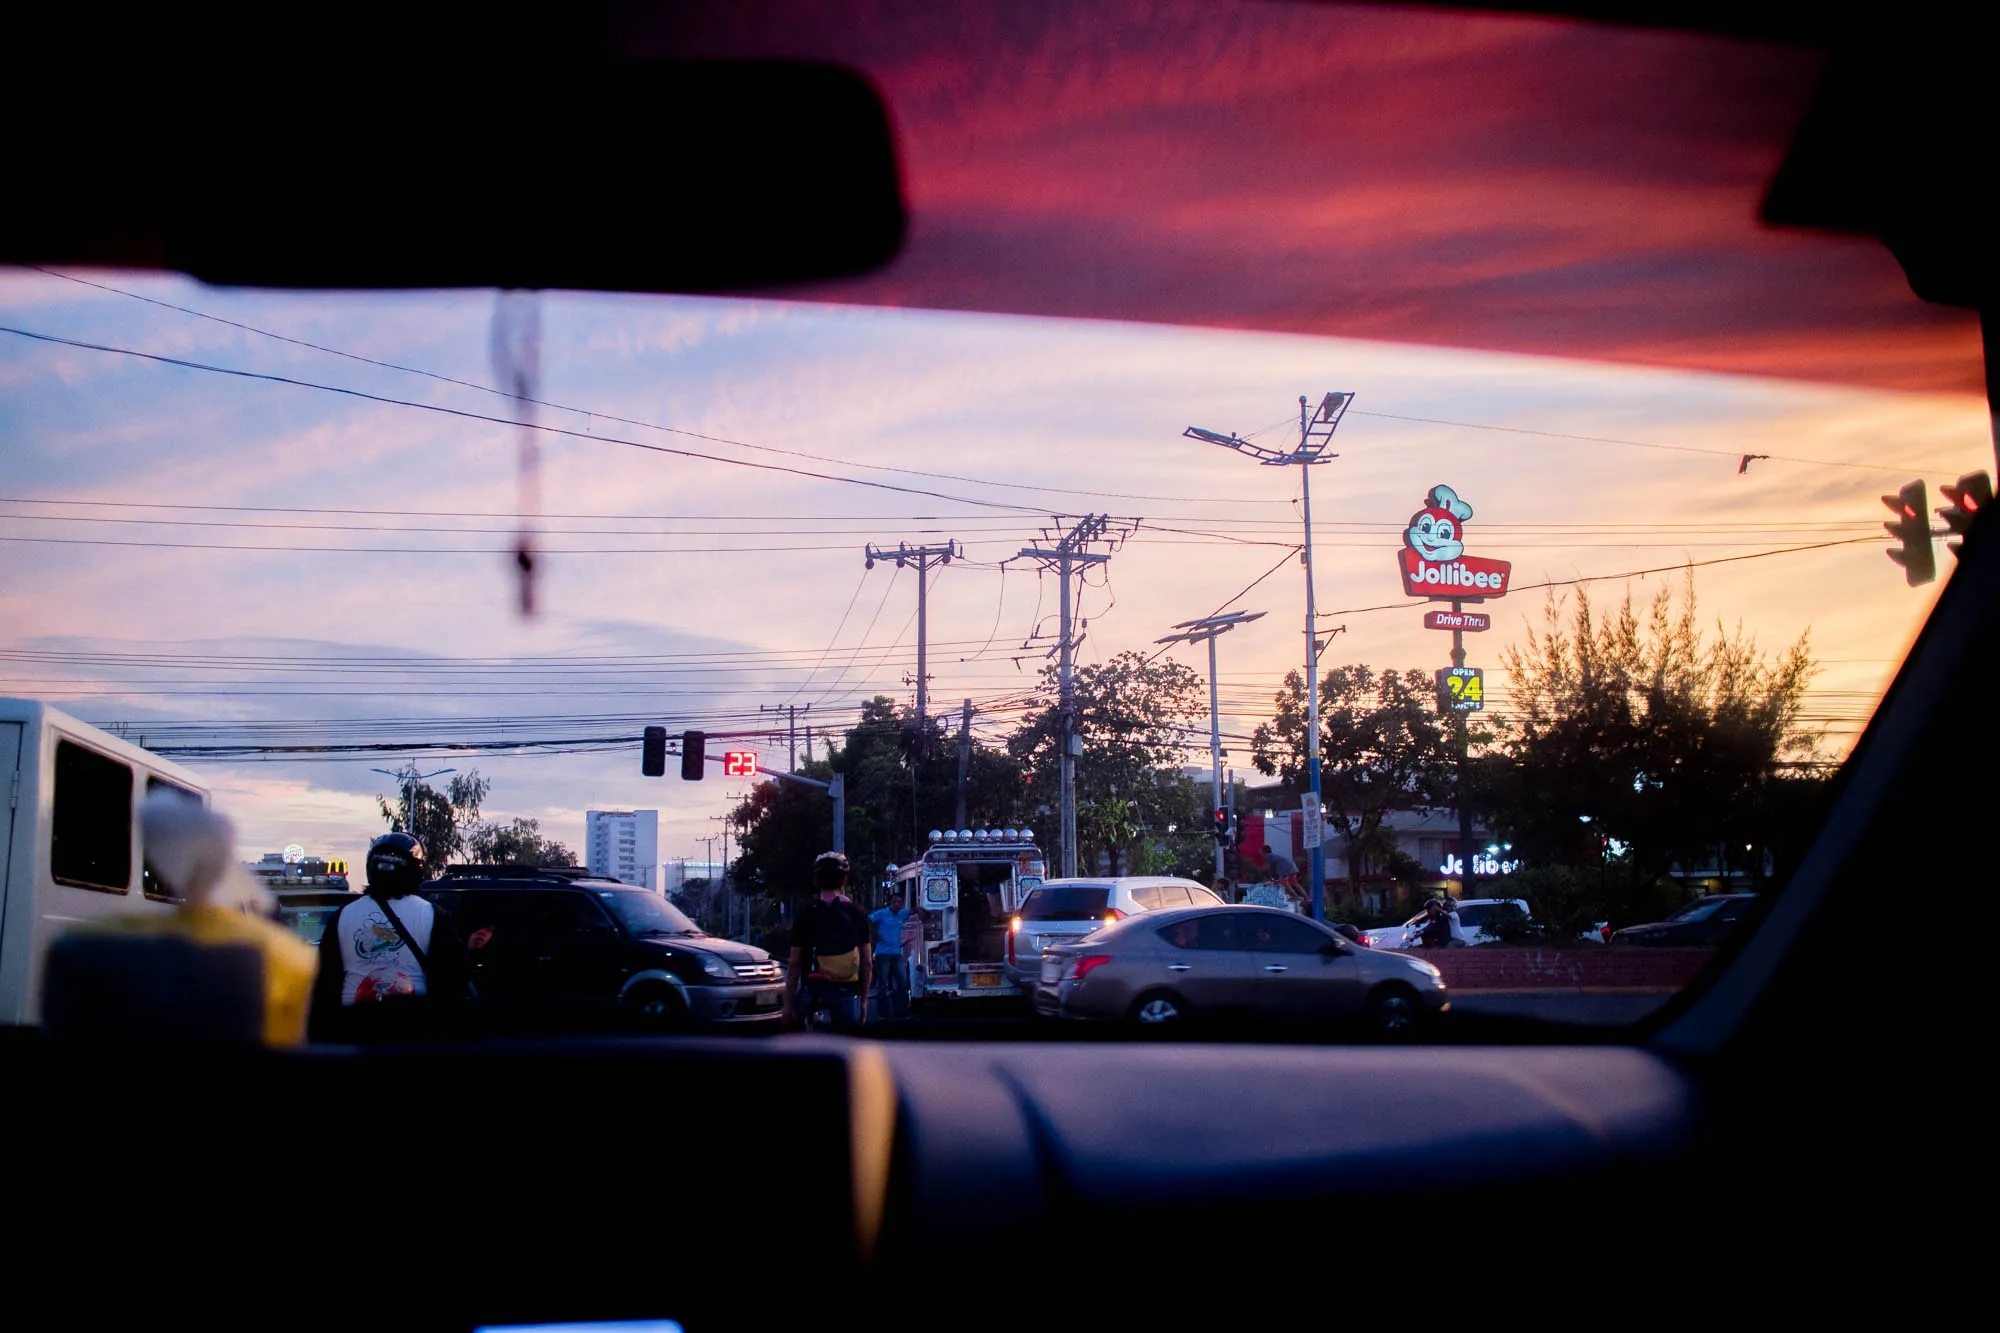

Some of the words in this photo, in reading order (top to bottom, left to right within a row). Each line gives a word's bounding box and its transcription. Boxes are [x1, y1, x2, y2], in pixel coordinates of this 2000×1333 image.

[1410, 561, 1502, 589] Jollibee
[1436, 613, 1462, 626] Drive
[1463, 615, 1485, 627] Thru
[1452, 668, 1475, 676] OPEN
[1447, 676, 1483, 701] 24
[728, 752, 756, 776] 23
